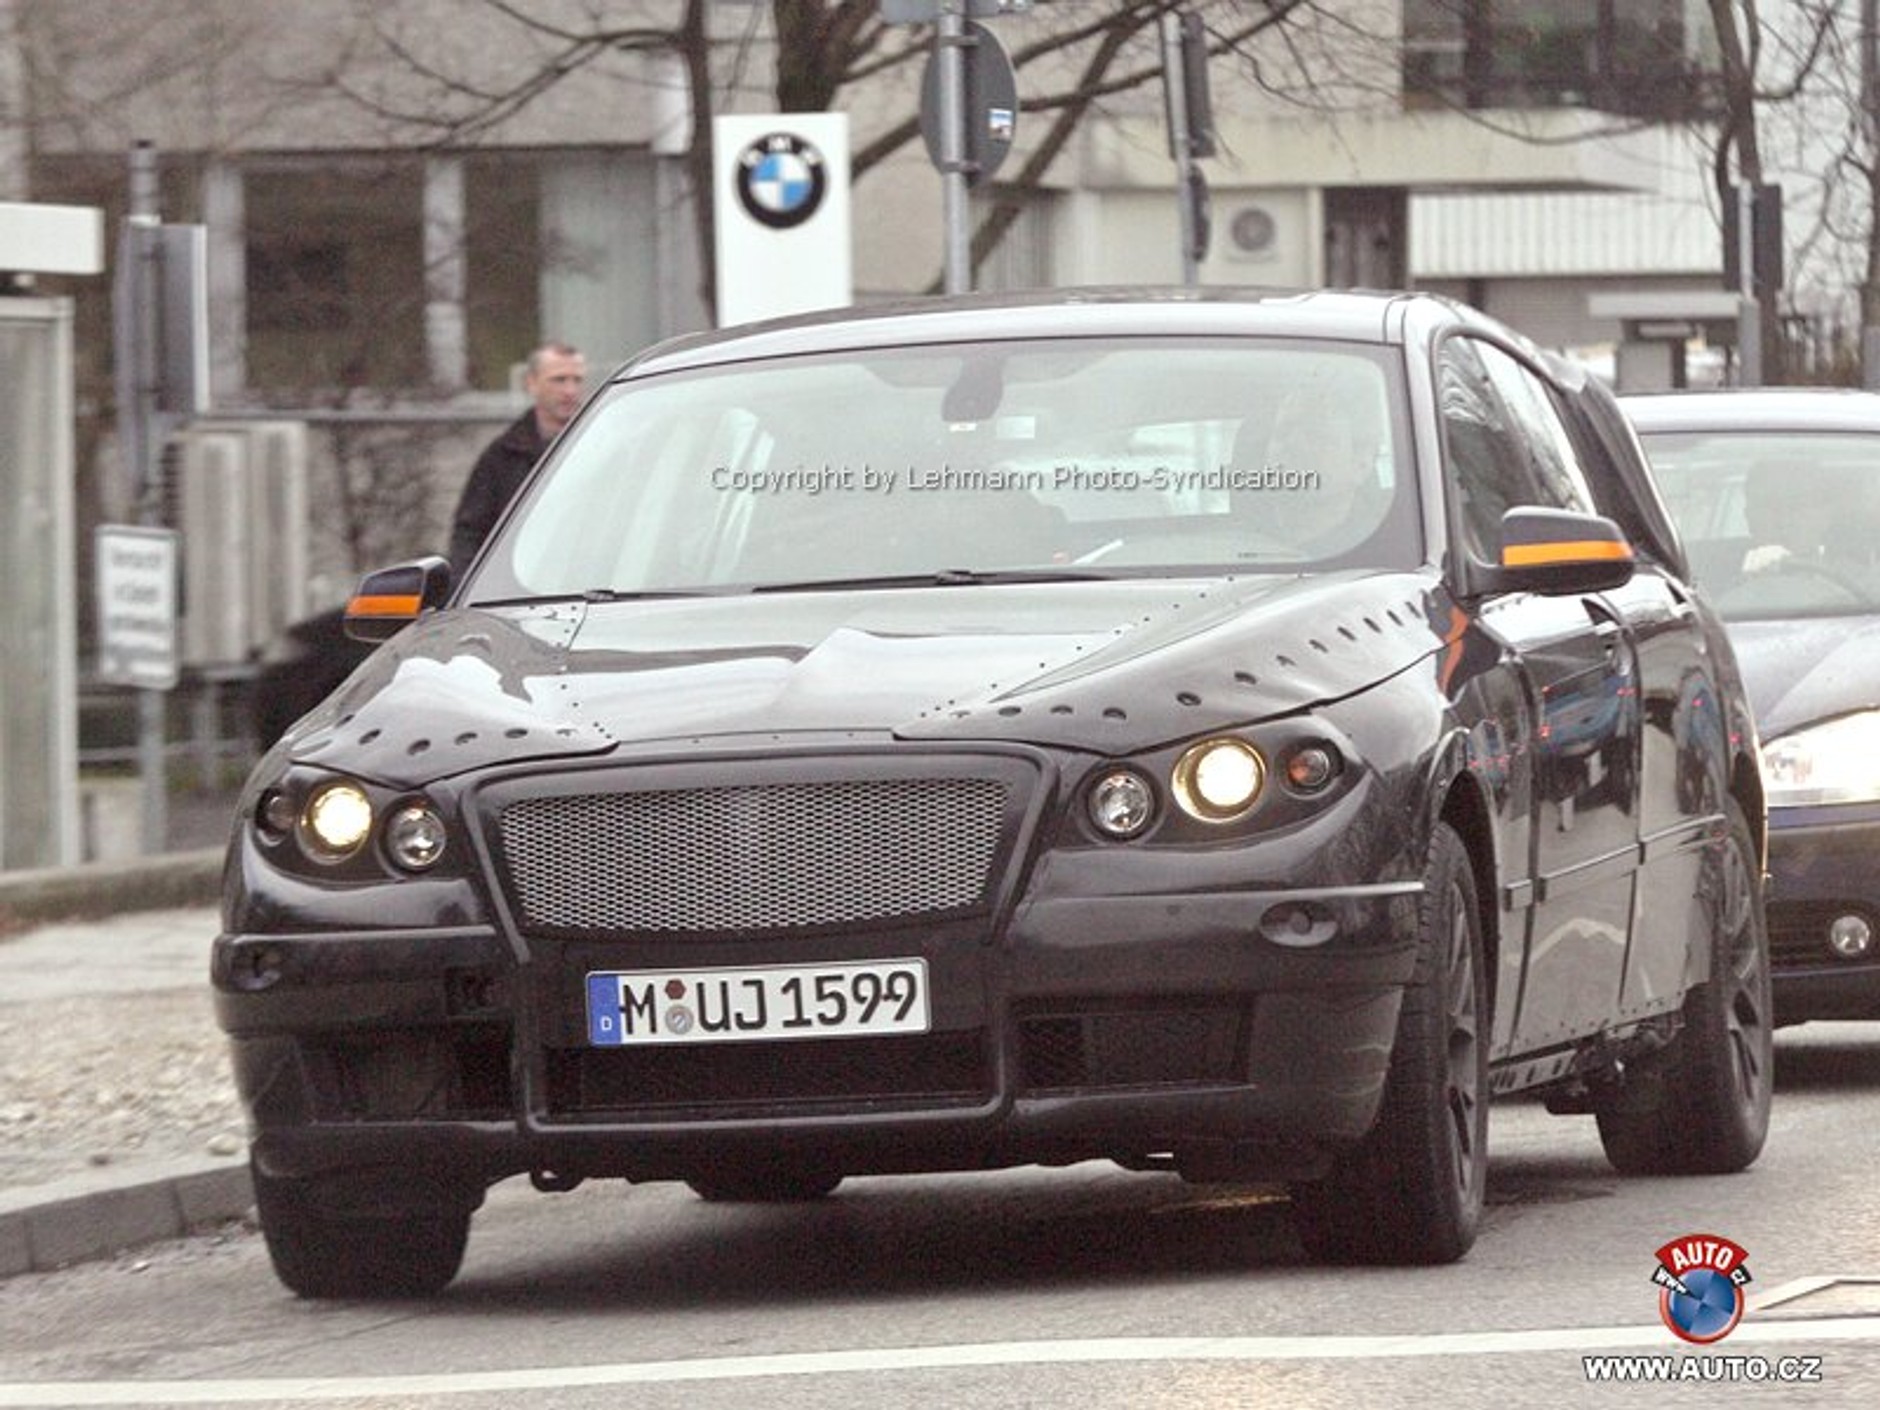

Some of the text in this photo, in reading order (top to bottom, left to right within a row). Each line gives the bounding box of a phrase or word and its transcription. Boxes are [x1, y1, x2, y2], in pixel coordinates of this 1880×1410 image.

[622, 970, 918, 1035] M UJ 1599
[601, 1016, 612, 1031] D
